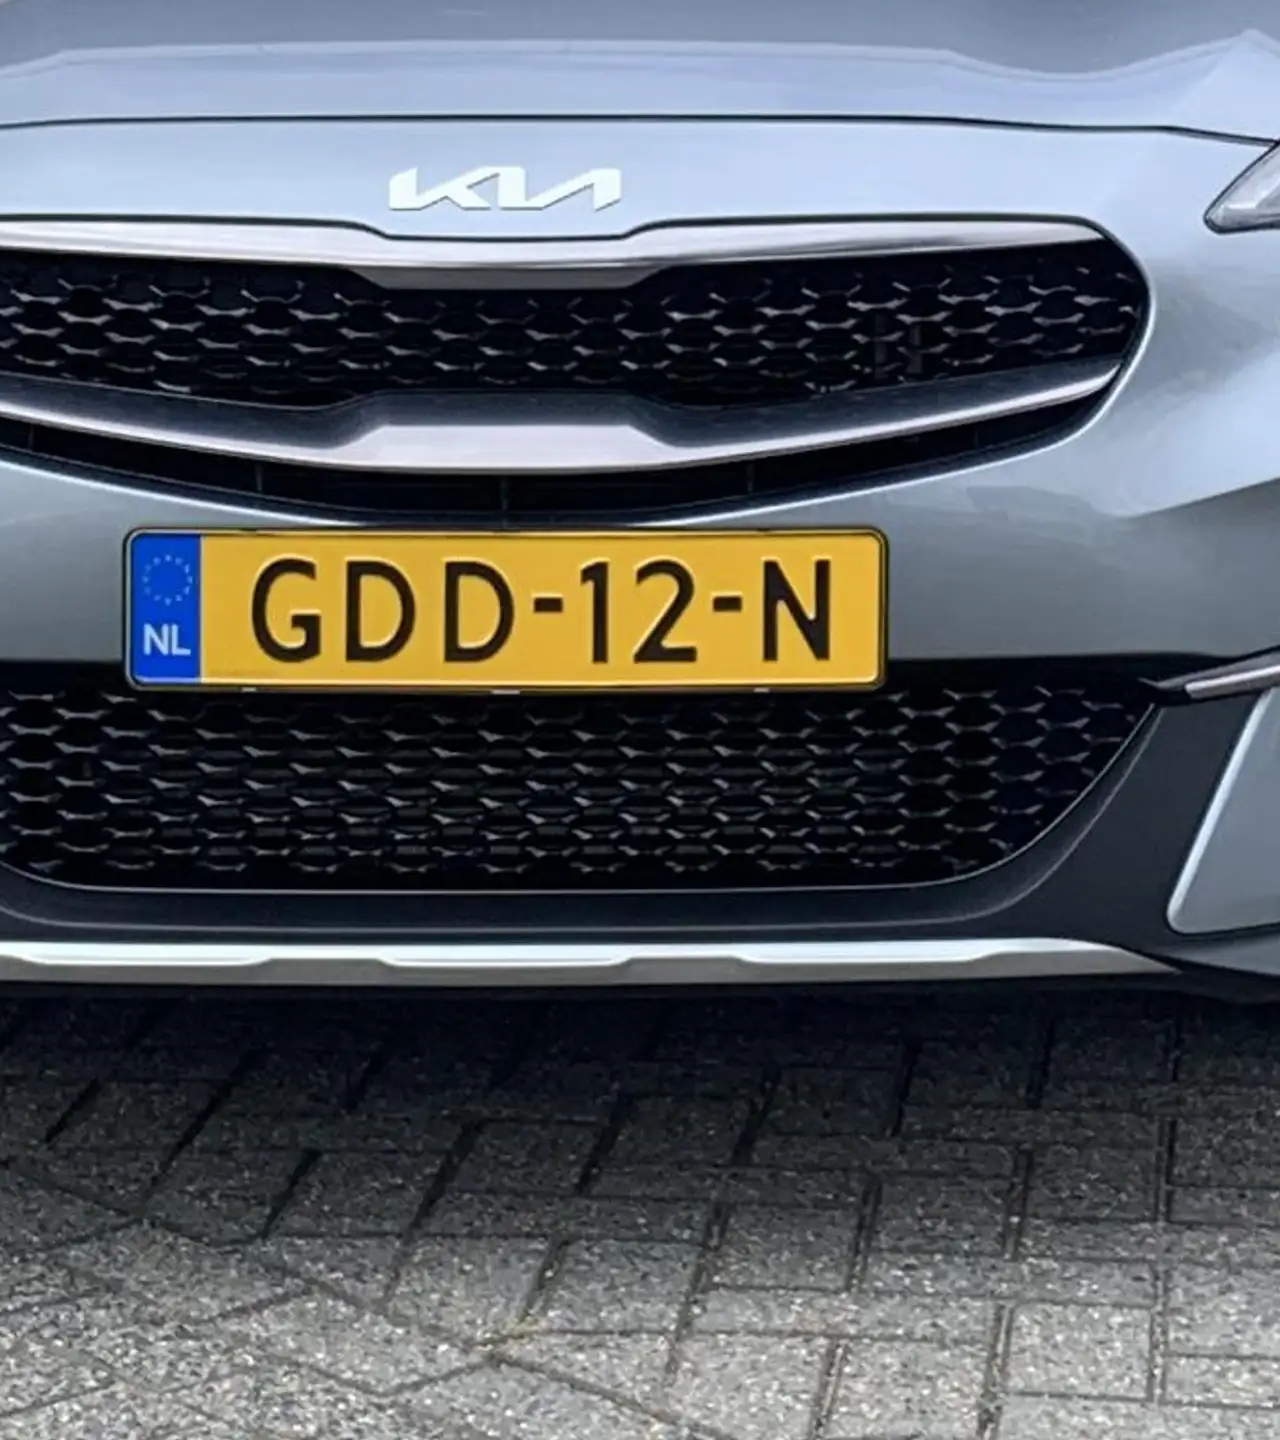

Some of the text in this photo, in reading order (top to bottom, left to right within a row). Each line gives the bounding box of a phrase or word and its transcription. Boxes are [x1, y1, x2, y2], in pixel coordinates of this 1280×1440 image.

[388, 166, 622, 212] KIA
[144, 557, 832, 664] NL GDD-12-N
